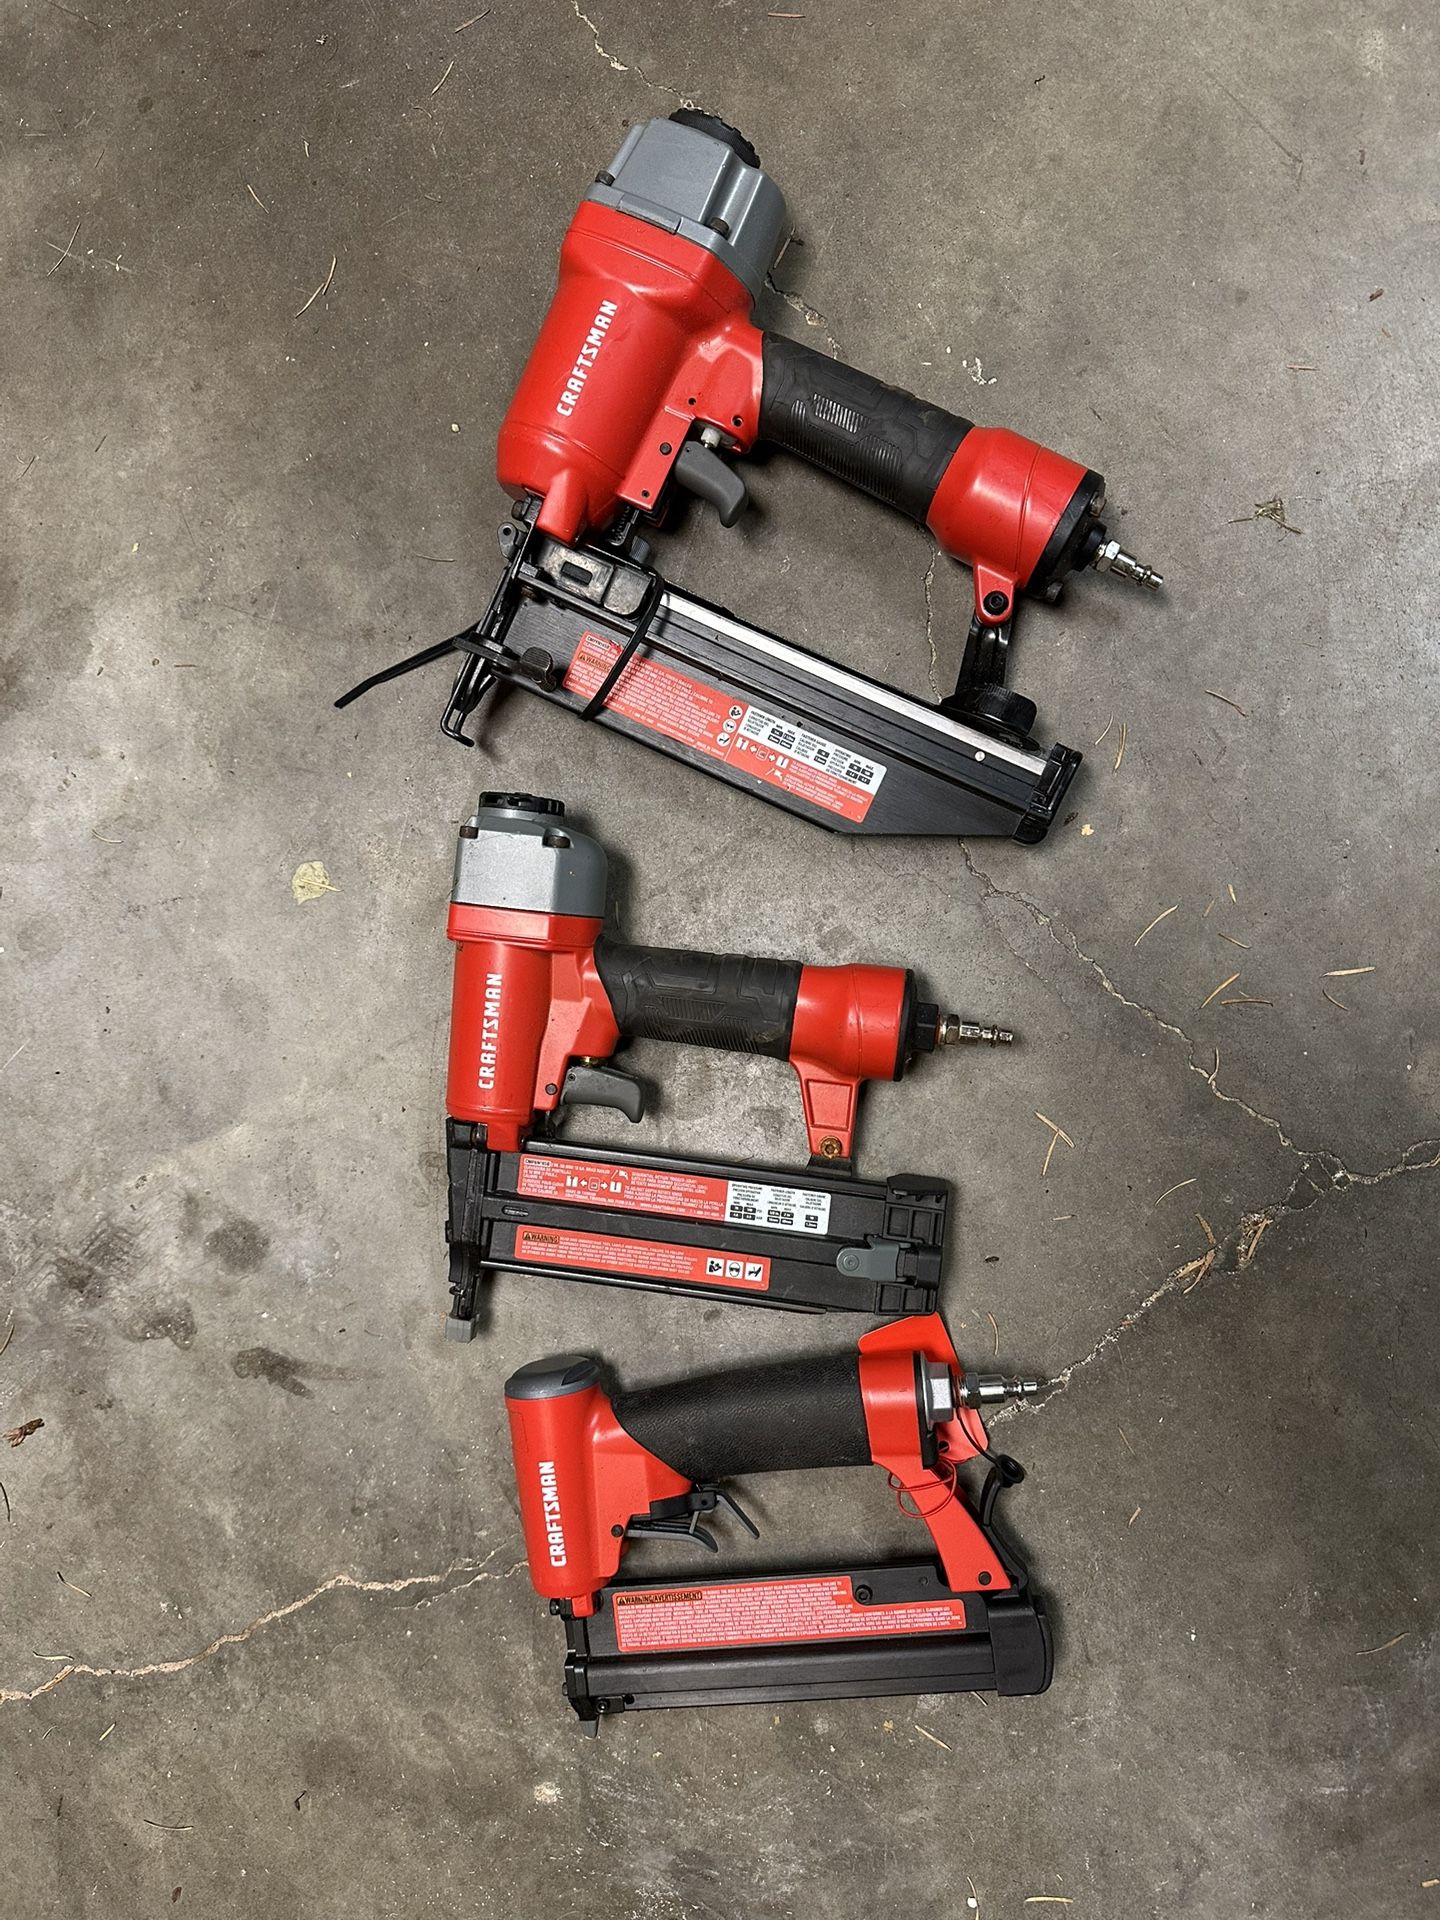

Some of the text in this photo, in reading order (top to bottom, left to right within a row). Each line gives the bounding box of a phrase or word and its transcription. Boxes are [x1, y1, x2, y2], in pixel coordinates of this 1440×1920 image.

[556, 299, 618, 417] CRAFTSMAN
[478, 972, 503, 1090] CRAFTSMAN
[538, 1461, 567, 1568] CRAFTSMAN
